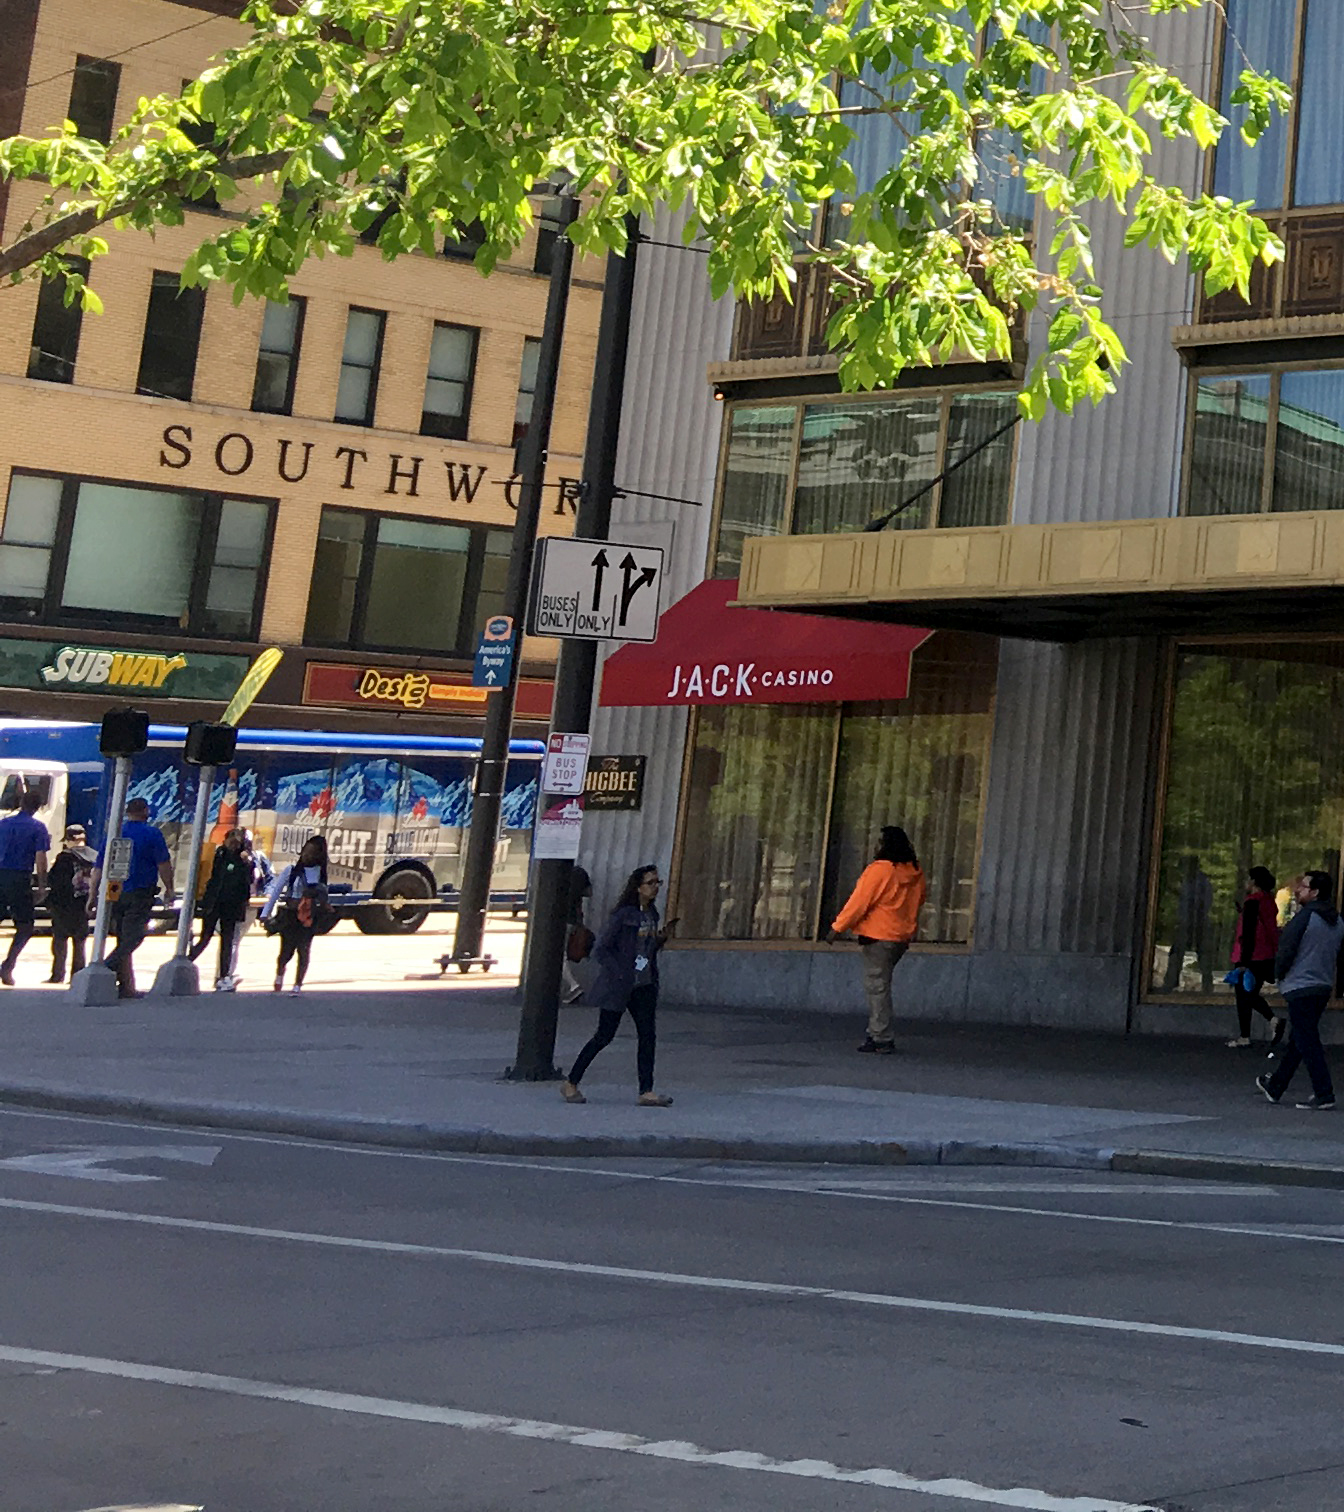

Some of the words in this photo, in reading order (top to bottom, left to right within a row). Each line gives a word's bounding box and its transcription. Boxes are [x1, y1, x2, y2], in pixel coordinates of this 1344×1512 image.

[543, 595, 576, 612] BUSES
[540, 612, 573, 627] ONLY
[577, 614, 610, 631] ONLY
[479, 644, 511, 655] America's
[41, 646, 188, 688] SUBWAY
[482, 655, 505, 667] Byway
[761, 669, 833, 687] CASINO
[551, 738, 562, 749] NO
[555, 758, 577, 768] BUS
[552, 769, 577, 780] STOP
[585, 771, 638, 791] HIGBEE
[293, 808, 345, 827] Labtt
